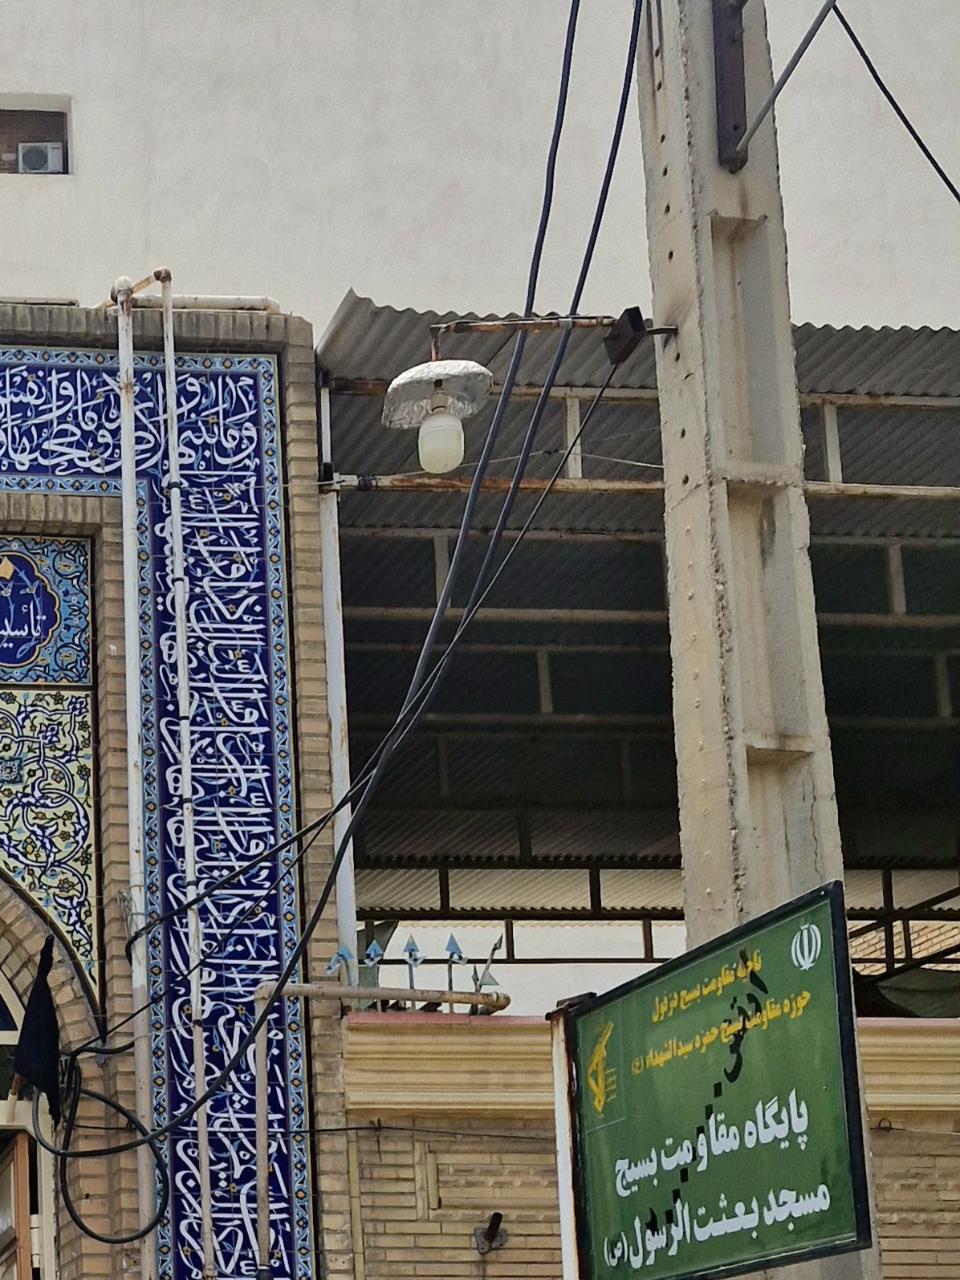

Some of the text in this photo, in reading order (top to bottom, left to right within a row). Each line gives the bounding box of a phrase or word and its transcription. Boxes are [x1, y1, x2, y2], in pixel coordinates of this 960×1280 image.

[744, 1088, 809, 1151] پایگاه
[615, 1147, 658, 1198] بسیج
[693, 1192, 759, 1241] بعثت
[763, 1184, 831, 1231] مسجد
